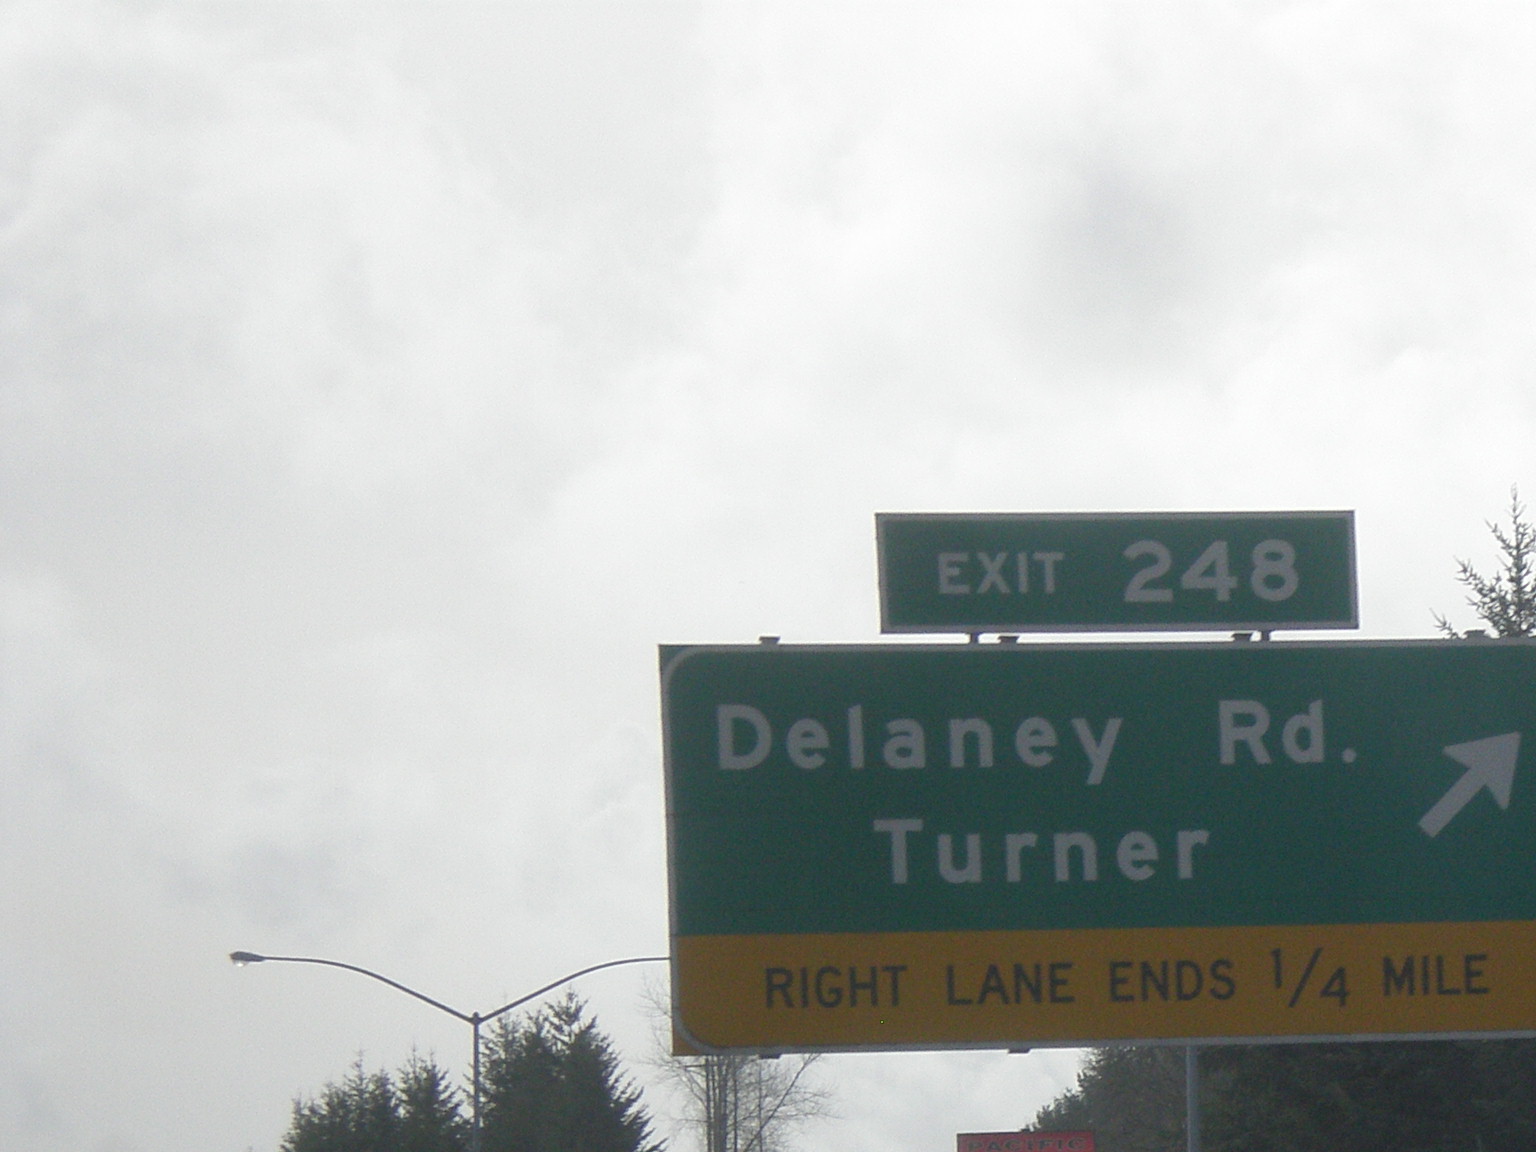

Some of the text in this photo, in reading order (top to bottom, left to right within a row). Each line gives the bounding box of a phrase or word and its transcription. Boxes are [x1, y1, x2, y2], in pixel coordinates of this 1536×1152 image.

[937, 538, 1300, 603] EXIT 248
[716, 699, 1358, 785] Delaney Rd.
[873, 817, 1210, 885] Turner
[764, 946, 1491, 1009] RIGHT LANE ENDS 1/4 MILE
[968, 1137, 1085, 1152] PACIFIC
